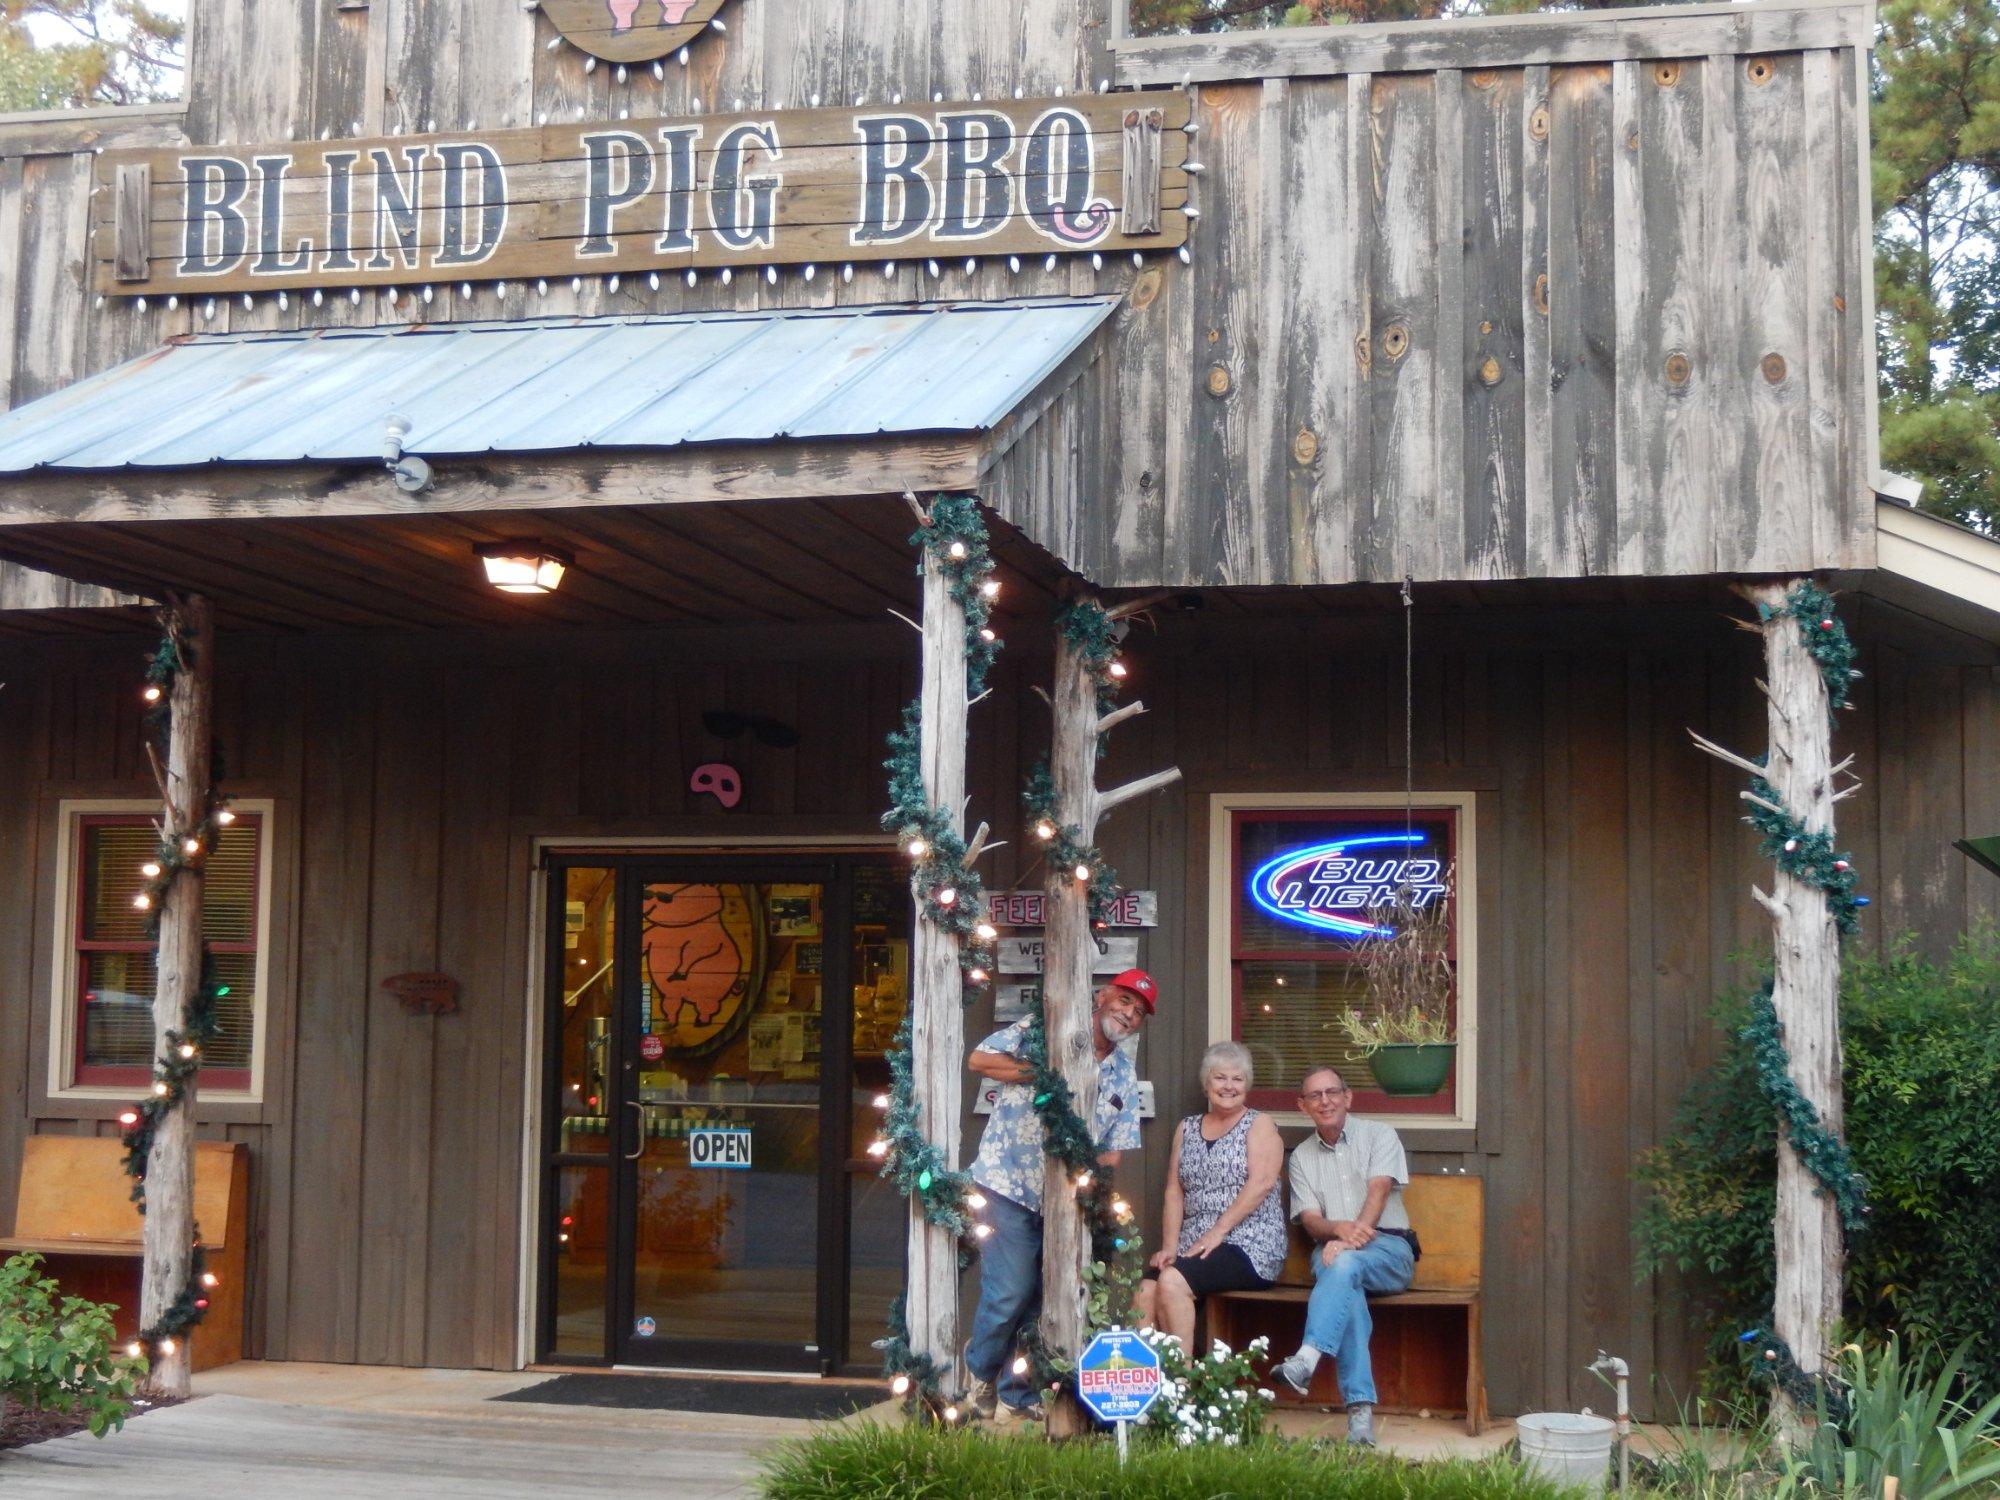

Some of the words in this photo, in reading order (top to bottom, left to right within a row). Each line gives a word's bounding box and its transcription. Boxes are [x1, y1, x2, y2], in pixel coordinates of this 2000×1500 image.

[177, 143, 508, 277] BLIND
[575, 120, 783, 259] PIG
[850, 107, 1115, 248] BBQ
[1309, 858, 1441, 883] BUD
[1278, 881, 1446, 909] LIGHT
[693, 1133, 749, 1162] OPEN
[1081, 1367, 1158, 1387] BEACON
